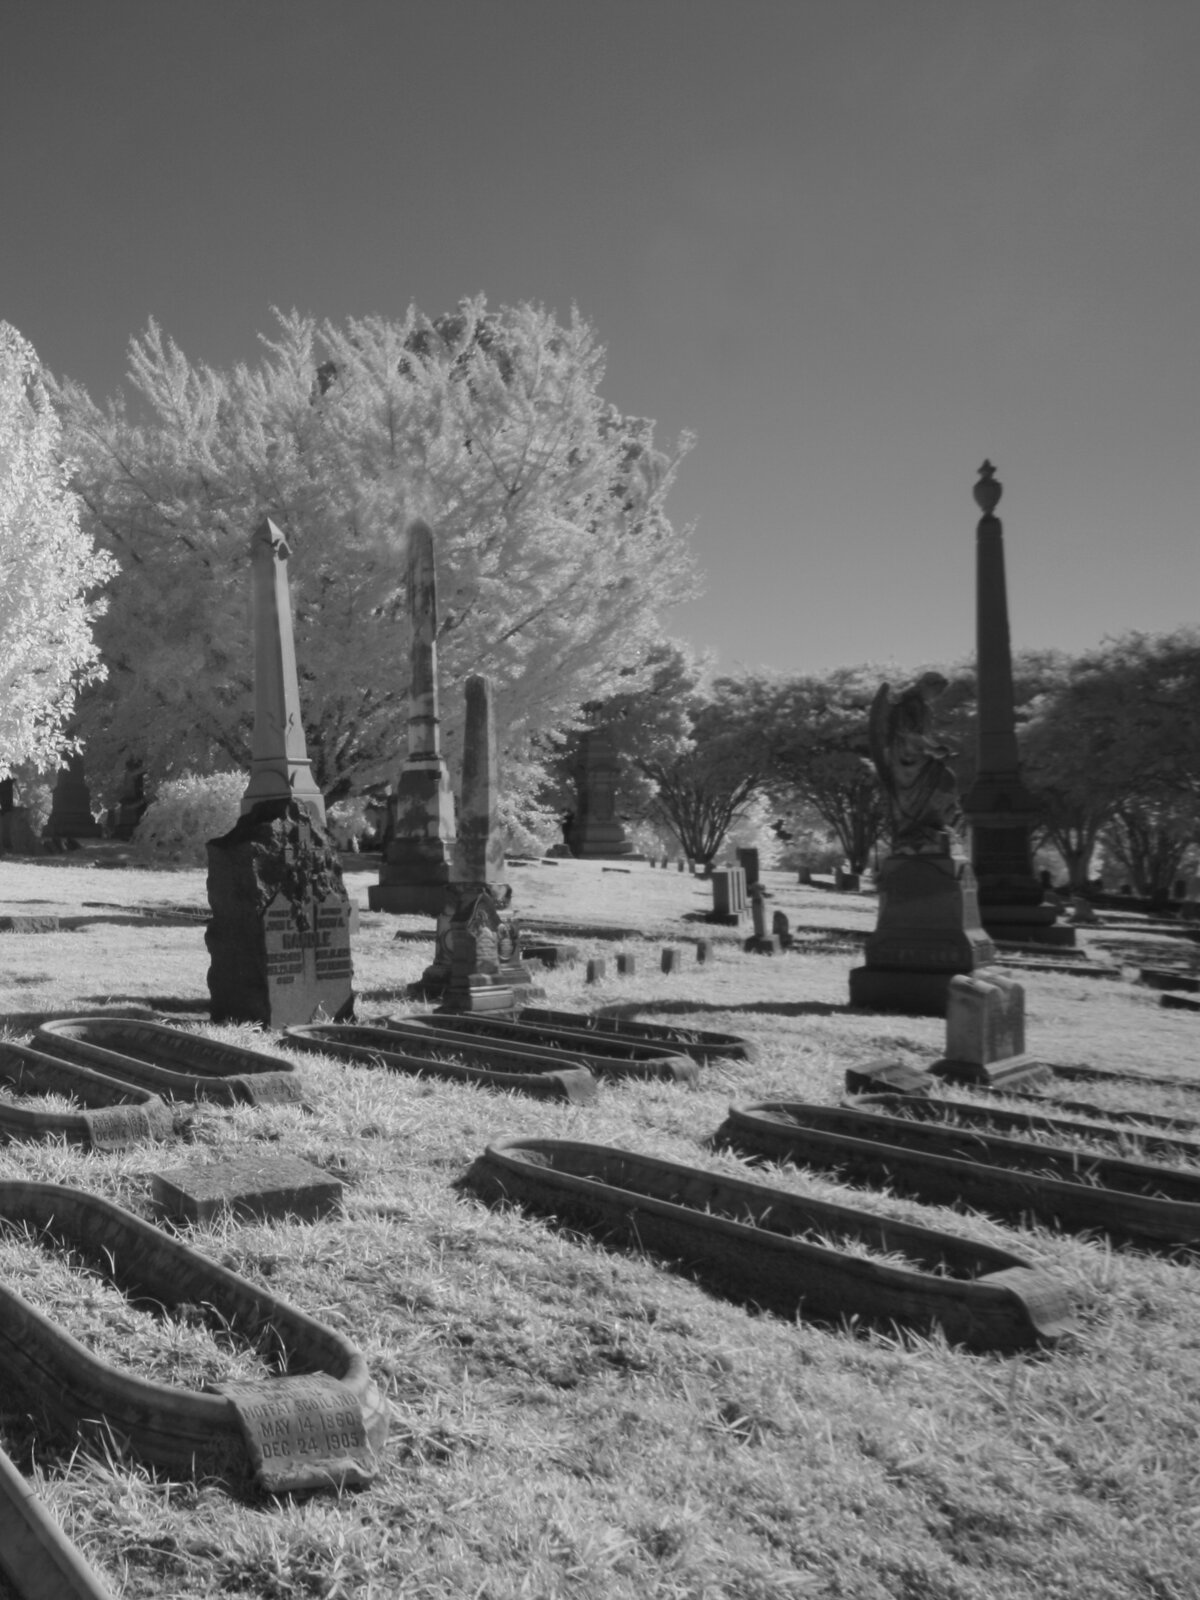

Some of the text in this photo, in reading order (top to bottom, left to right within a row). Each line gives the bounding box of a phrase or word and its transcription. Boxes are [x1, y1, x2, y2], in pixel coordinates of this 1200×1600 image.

[241, 1393, 359, 1420] MOFFAT SCOTLAND
[260, 1419, 290, 1439] MAY
